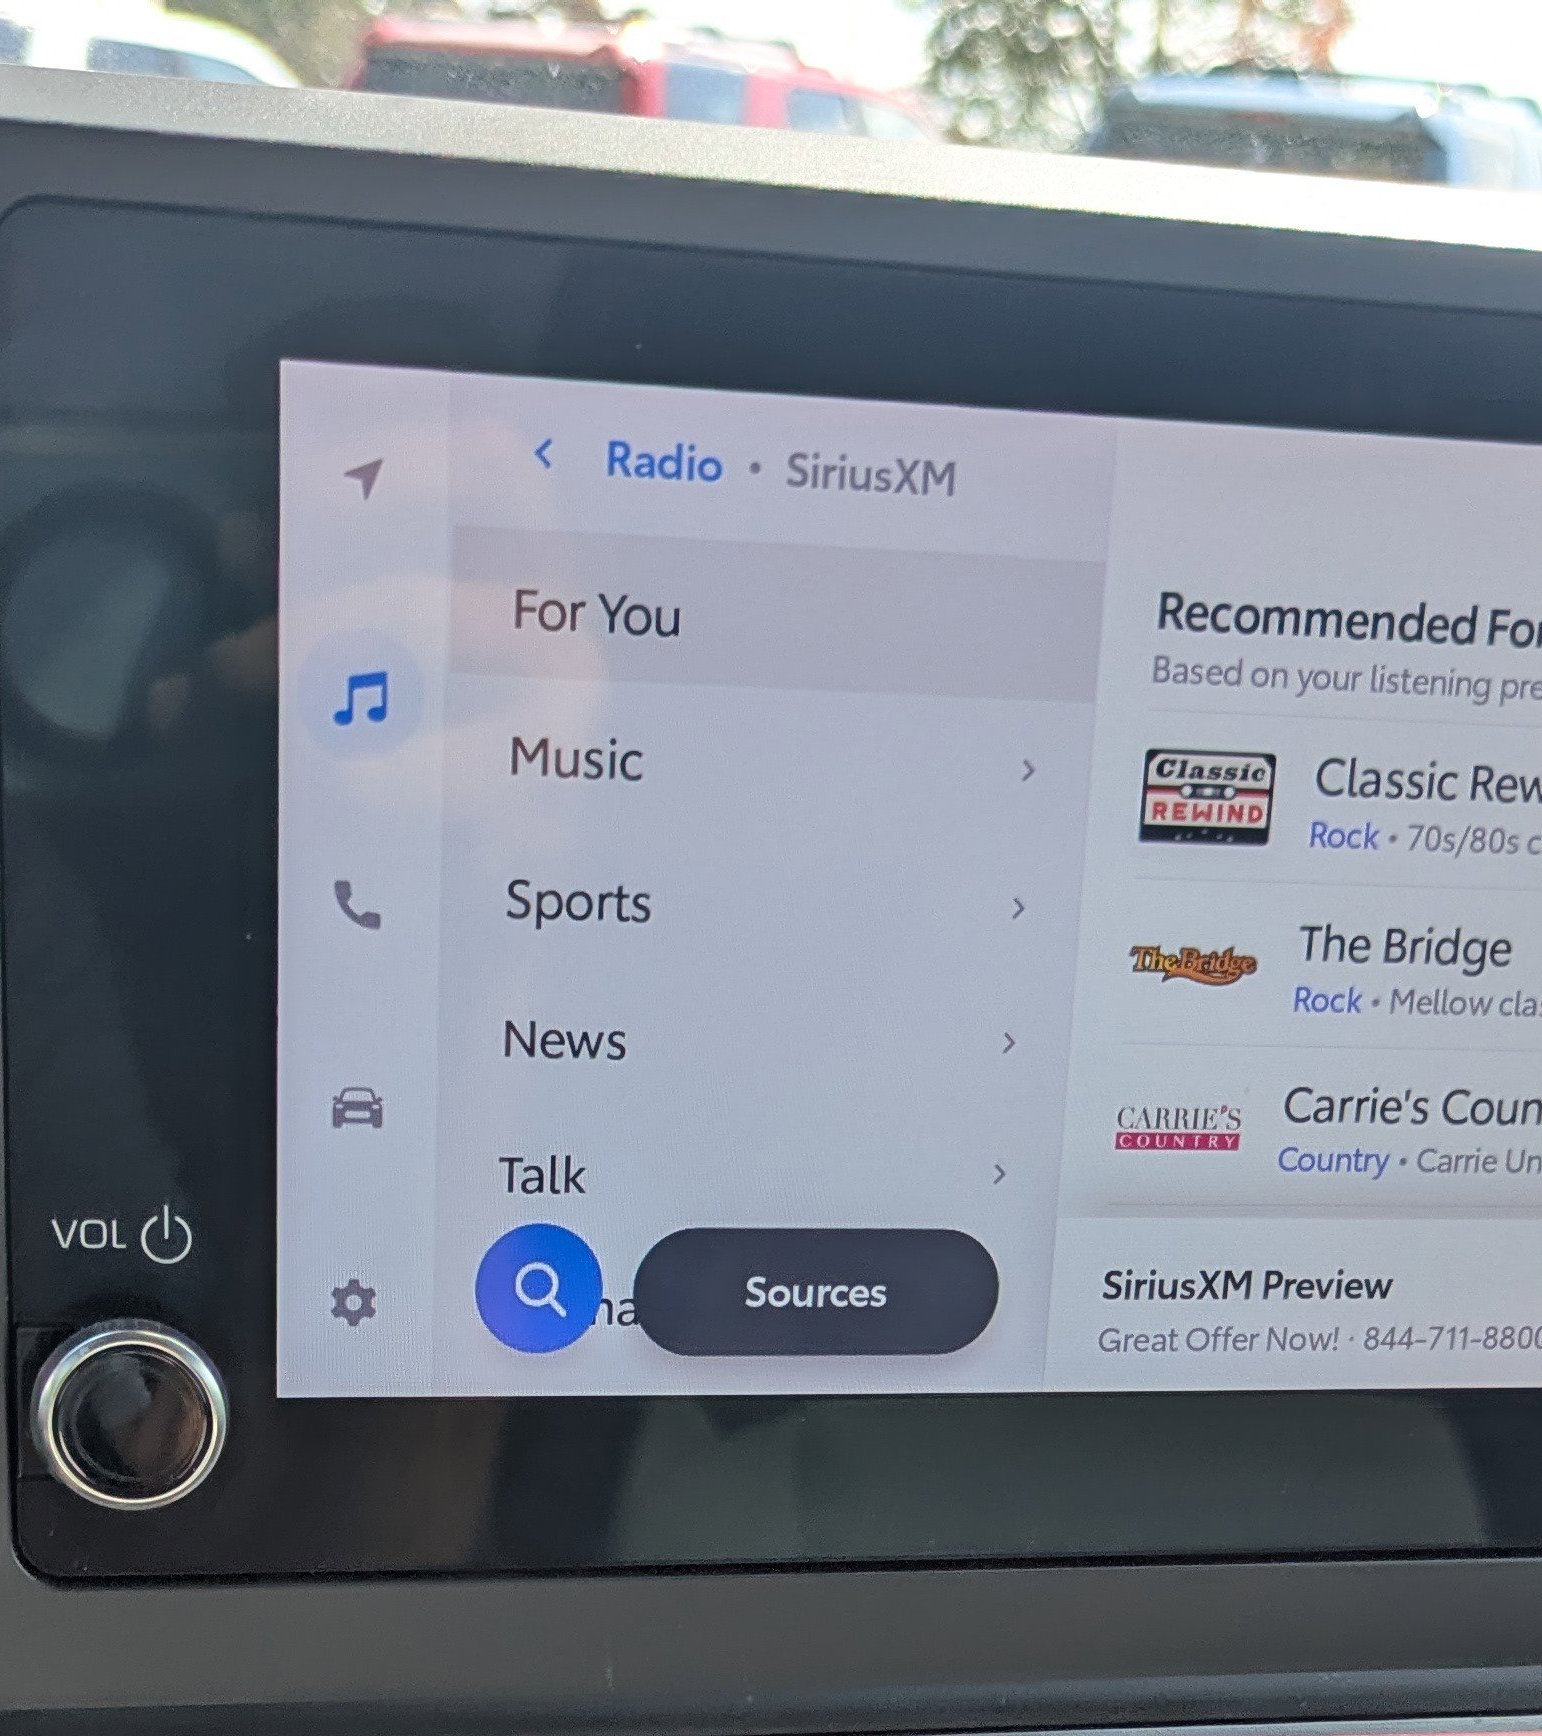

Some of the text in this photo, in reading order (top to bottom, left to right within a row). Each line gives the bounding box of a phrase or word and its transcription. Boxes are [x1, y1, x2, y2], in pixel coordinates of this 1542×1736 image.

[607, 440, 957, 498] Radio SiriusXM
[513, 589, 682, 638] For You
[1157, 591, 1479, 648] Recommended
[1152, 656, 1244, 688] Based
[1251, 667, 1289, 689] on
[1296, 667, 1362, 697] your
[1370, 664, 1491, 706] listening
[510, 736, 645, 782] Music
[1155, 758, 1266, 782] Classic
[1316, 757, 1458, 803] Classic
[1152, 801, 1264, 825] REWIND
[1310, 820, 1379, 852] Rock
[1408, 824, 1520, 858] 70s/80s
[506, 879, 652, 929] Sports
[1130, 945, 1258, 982] The Bridge
[1300, 925, 1512, 975] The Bridge
[1293, 987, 1361, 1014] Rock
[1389, 988, 1494, 1017] Mellow
[502, 1020, 627, 1061] News
[1116, 1105, 1242, 1132] CARRIE'S
[1283, 1086, 1429, 1126] Carrie's
[1118, 1133, 1239, 1150] COUNTRY
[499, 1155, 587, 1195] Talk
[1277, 1147, 1390, 1180] Country
[1416, 1147, 1498, 1175] Carrie
[51, 1218, 127, 1250] VOL
[745, 1276, 887, 1310] Sources
[1101, 1269, 1394, 1302] SiriusXM Preview
[1097, 1326, 1178, 1355] Great
[1185, 1325, 1259, 1354] Offer
[1266, 1326, 1339, 1353] Now!
